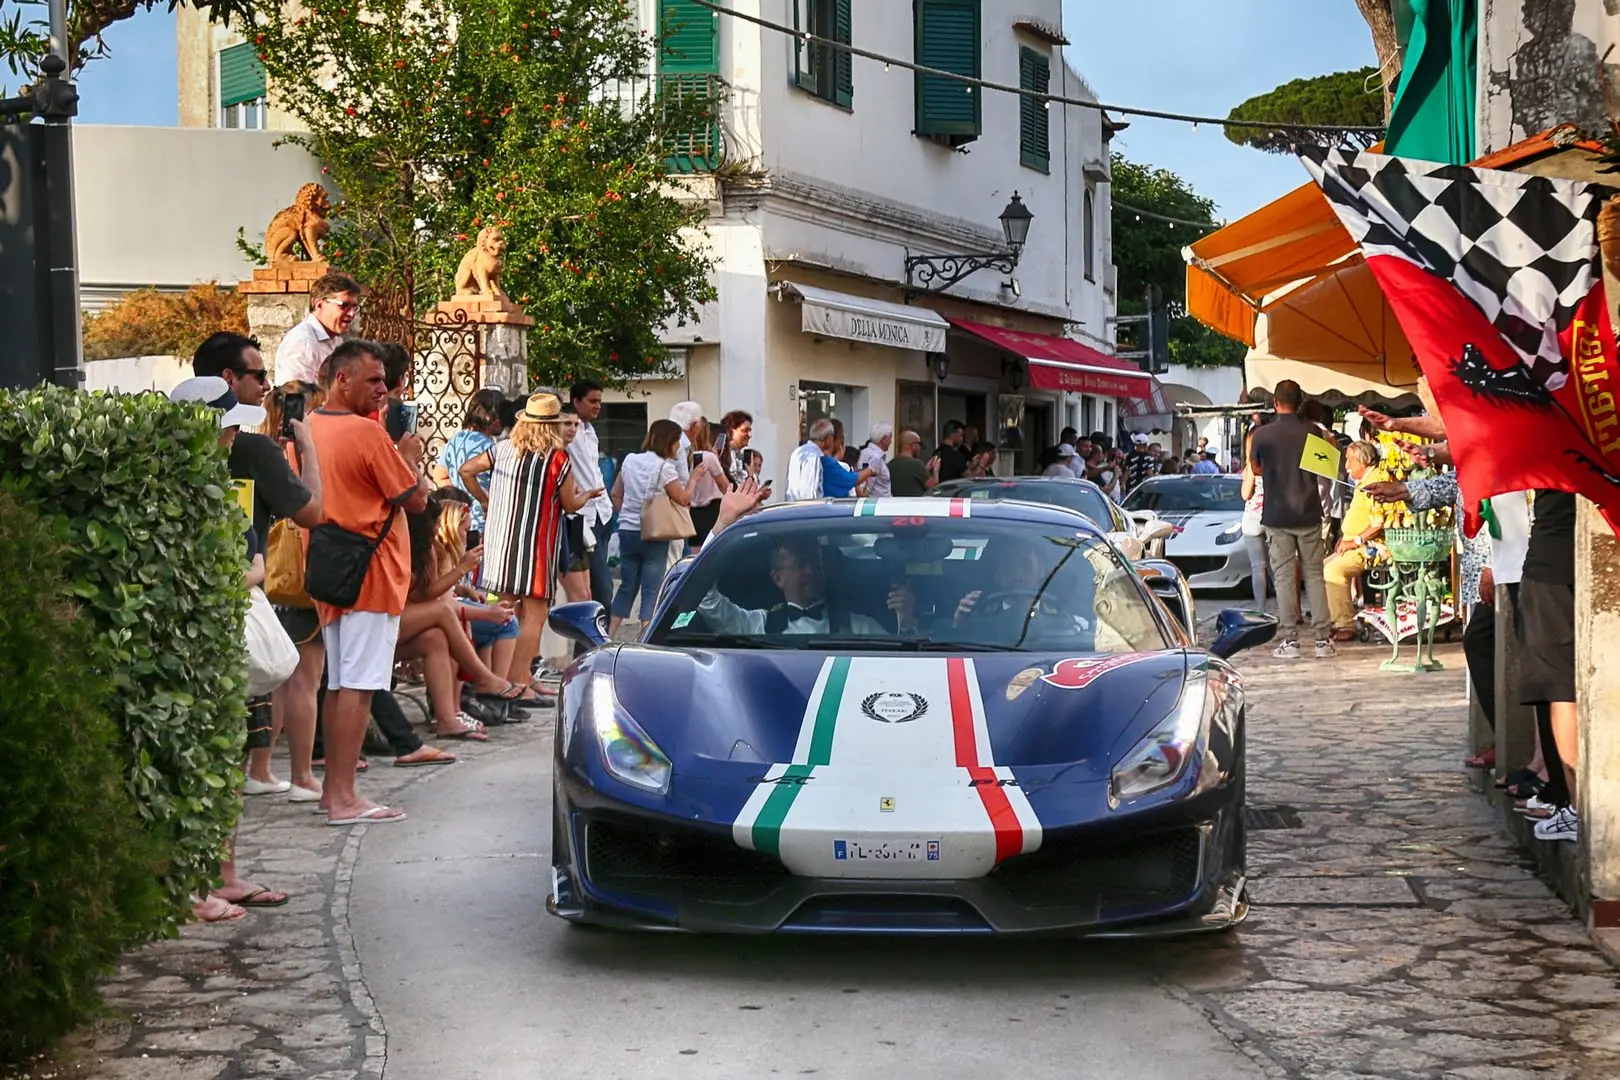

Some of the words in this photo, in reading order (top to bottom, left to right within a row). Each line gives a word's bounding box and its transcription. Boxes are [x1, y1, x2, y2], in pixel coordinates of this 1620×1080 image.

[851, 317, 877, 338] DELLA
[878, 322, 909, 343] MONICA
[892, 516, 926, 526] 20
